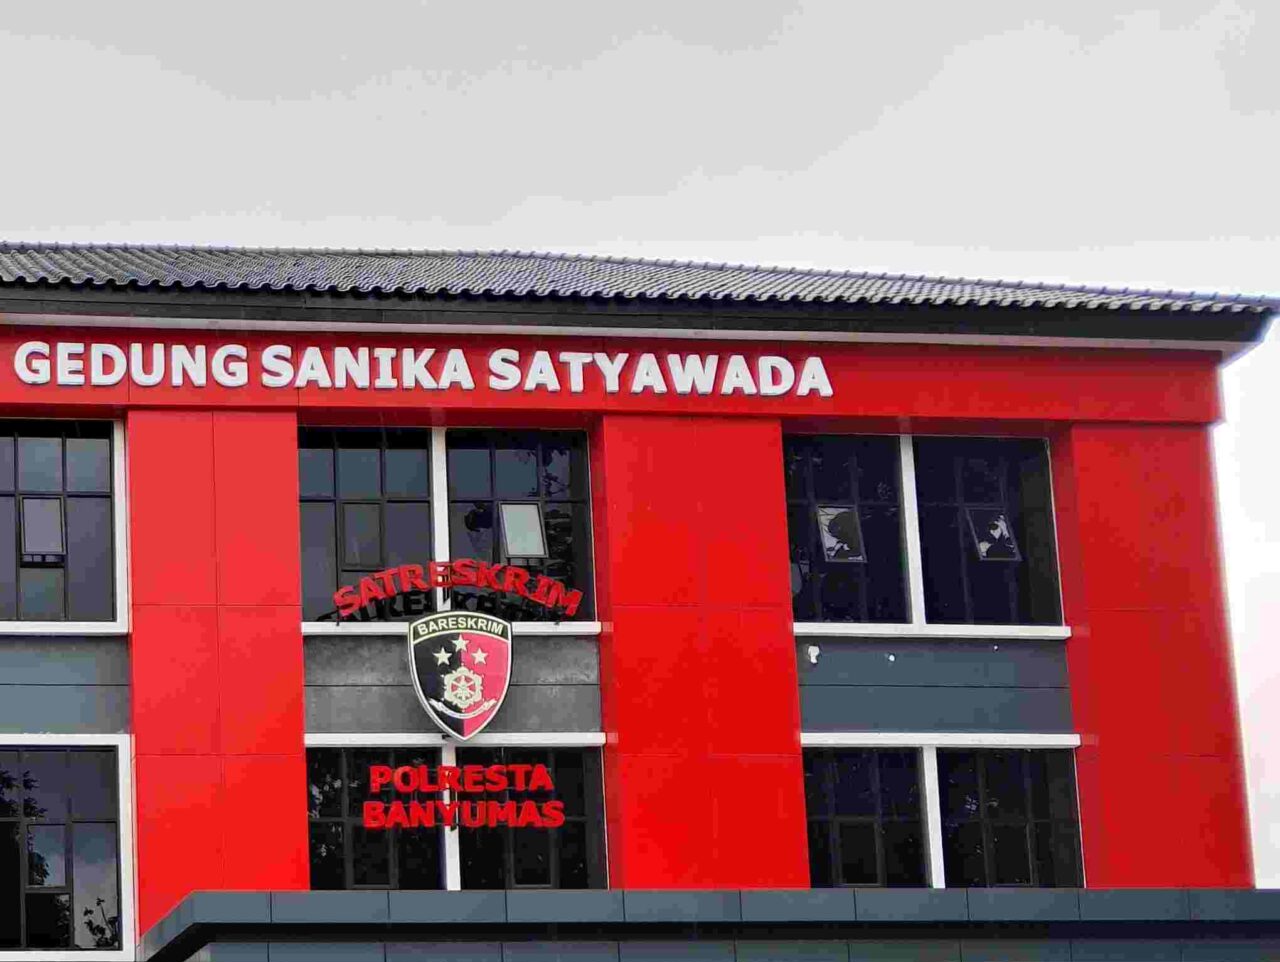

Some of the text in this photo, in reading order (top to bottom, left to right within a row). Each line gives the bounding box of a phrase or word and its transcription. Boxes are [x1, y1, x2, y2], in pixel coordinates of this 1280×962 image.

[13, 340, 833, 397] GEDUNG SANIKA SATYAWADA
[333, 558, 584, 617] SATRESKRIM
[417, 617, 504, 636] BARESKRIM
[368, 764, 555, 793] POLRESTA
[362, 800, 566, 828] BANYUMAS
